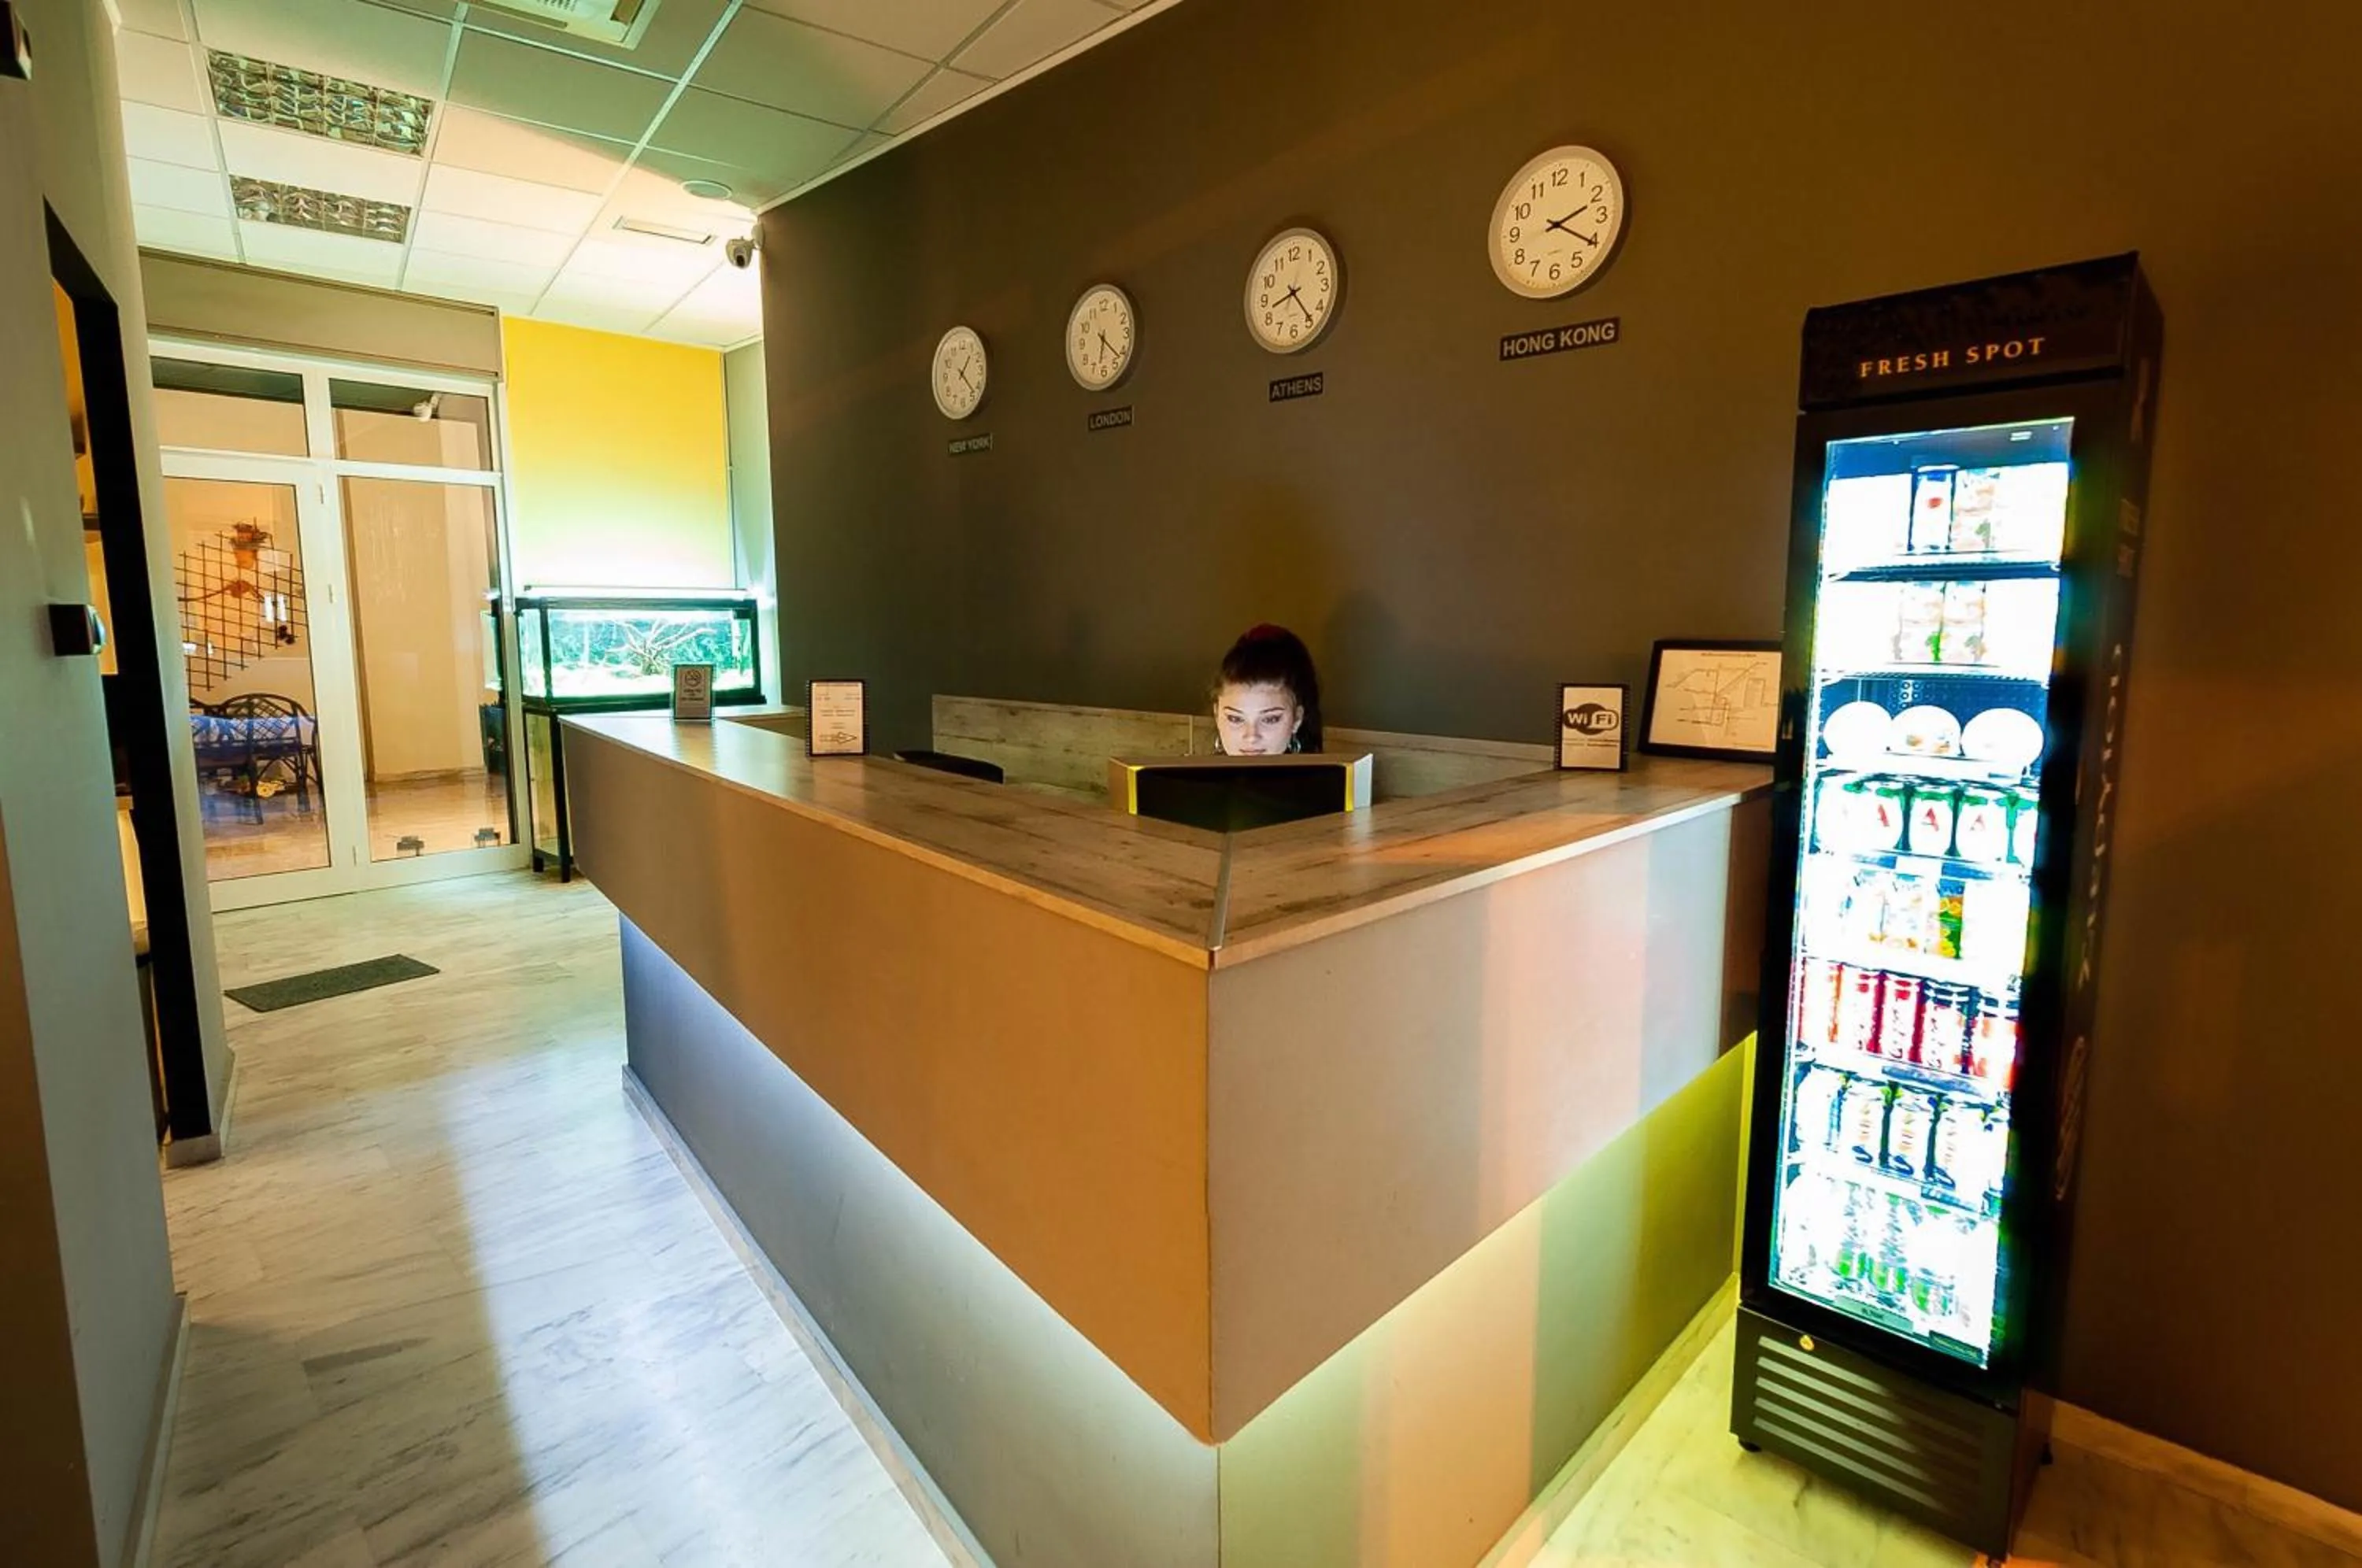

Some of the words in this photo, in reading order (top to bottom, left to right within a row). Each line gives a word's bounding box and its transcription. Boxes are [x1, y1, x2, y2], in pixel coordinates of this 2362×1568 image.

[1551, 168, 1569, 187] 12
[1579, 171, 1585, 188] 1
[1531, 182, 1544, 200] 11
[1590, 185, 1603, 204] 2
[1514, 202, 1531, 221] 10
[1595, 205, 1608, 224] 3
[1509, 226, 1520, 243] 9
[1288, 246, 1300, 262] 12
[1308, 249, 1312, 263] 1
[1513, 248, 1525, 265] 8
[1571, 251, 1583, 268] 5
[1274, 257, 1284, 272] 11
[1316, 260, 1325, 276] 2
[1530, 259, 1541, 277] 7
[1549, 263, 1561, 280] 6
[1263, 274, 1275, 290] 10
[1320, 277, 1330, 292] 3
[1098, 298, 1109, 312] 12
[1113, 301, 1117, 313] 1
[1261, 294, 1268, 308] 9
[1316, 299, 1324, 312] 4
[1089, 308, 1097, 320] 11
[1120, 312, 1127, 325] 2
[1264, 312, 1273, 326] 8
[1080, 321, 1090, 334] 10
[1123, 327, 1130, 339] 3
[1275, 322, 1283, 335] 7
[1289, 324, 1298, 338] 6
[1079, 338, 1086, 349] 9
[1502, 333, 1555, 357] HONG
[1559, 322, 1615, 347] KONG
[1083, 353, 1089, 365] 8
[1112, 357, 1119, 370] 5
[1858, 350, 1950, 378] FRESH
[1965, 337, 2045, 364] SPOT
[1091, 362, 1097, 375] 7
[1101, 365, 1108, 377] 6
[1272, 377, 1322, 399] ATHENS
[1090, 410, 1131, 429] LONDON
[949, 441, 966, 454] NEW
[968, 436, 990, 450] YORK
